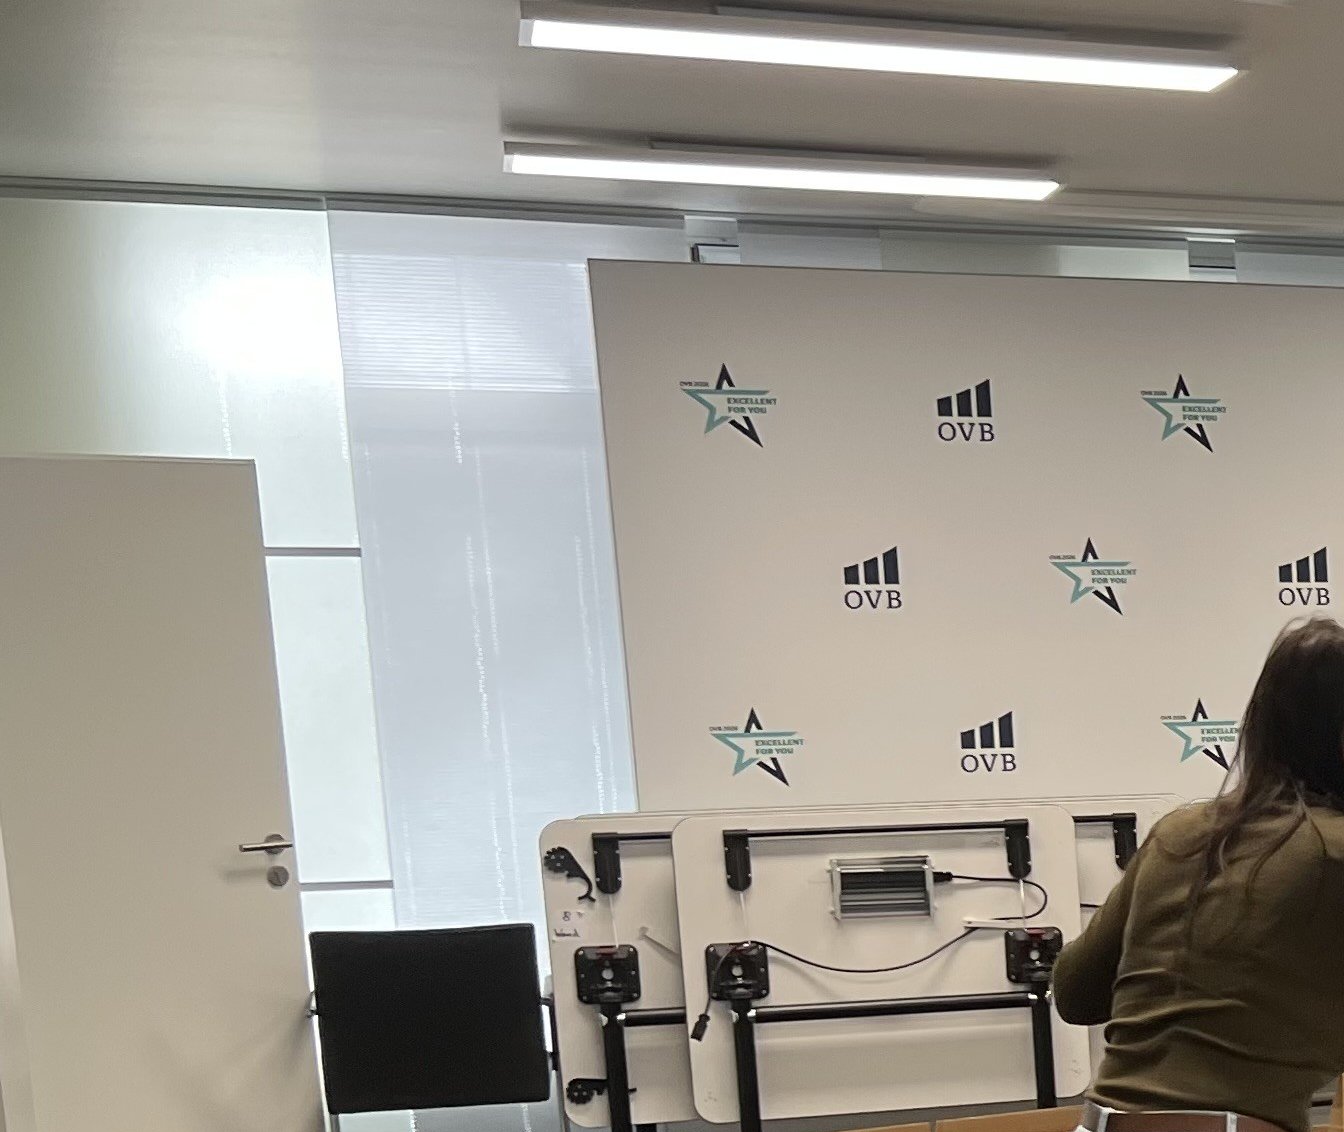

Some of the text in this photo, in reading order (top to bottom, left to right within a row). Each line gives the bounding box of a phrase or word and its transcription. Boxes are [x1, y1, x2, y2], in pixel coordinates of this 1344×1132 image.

[727, 397, 777, 405] EXCELLENT
[728, 406, 767, 414] FOR YOU
[1182, 405, 1226, 413] EXCELLENT
[937, 422, 995, 442] OVB
[844, 590, 903, 610] OVB
[1278, 587, 1331, 606] OVB
[1201, 727, 1240, 735] EXCELLEN
[755, 739, 804, 747] EXCELLENT
[1201, 735, 1236, 743] FOR YOU
[756, 747, 794, 755] FOR YOU
[960, 753, 1017, 773] OVB
